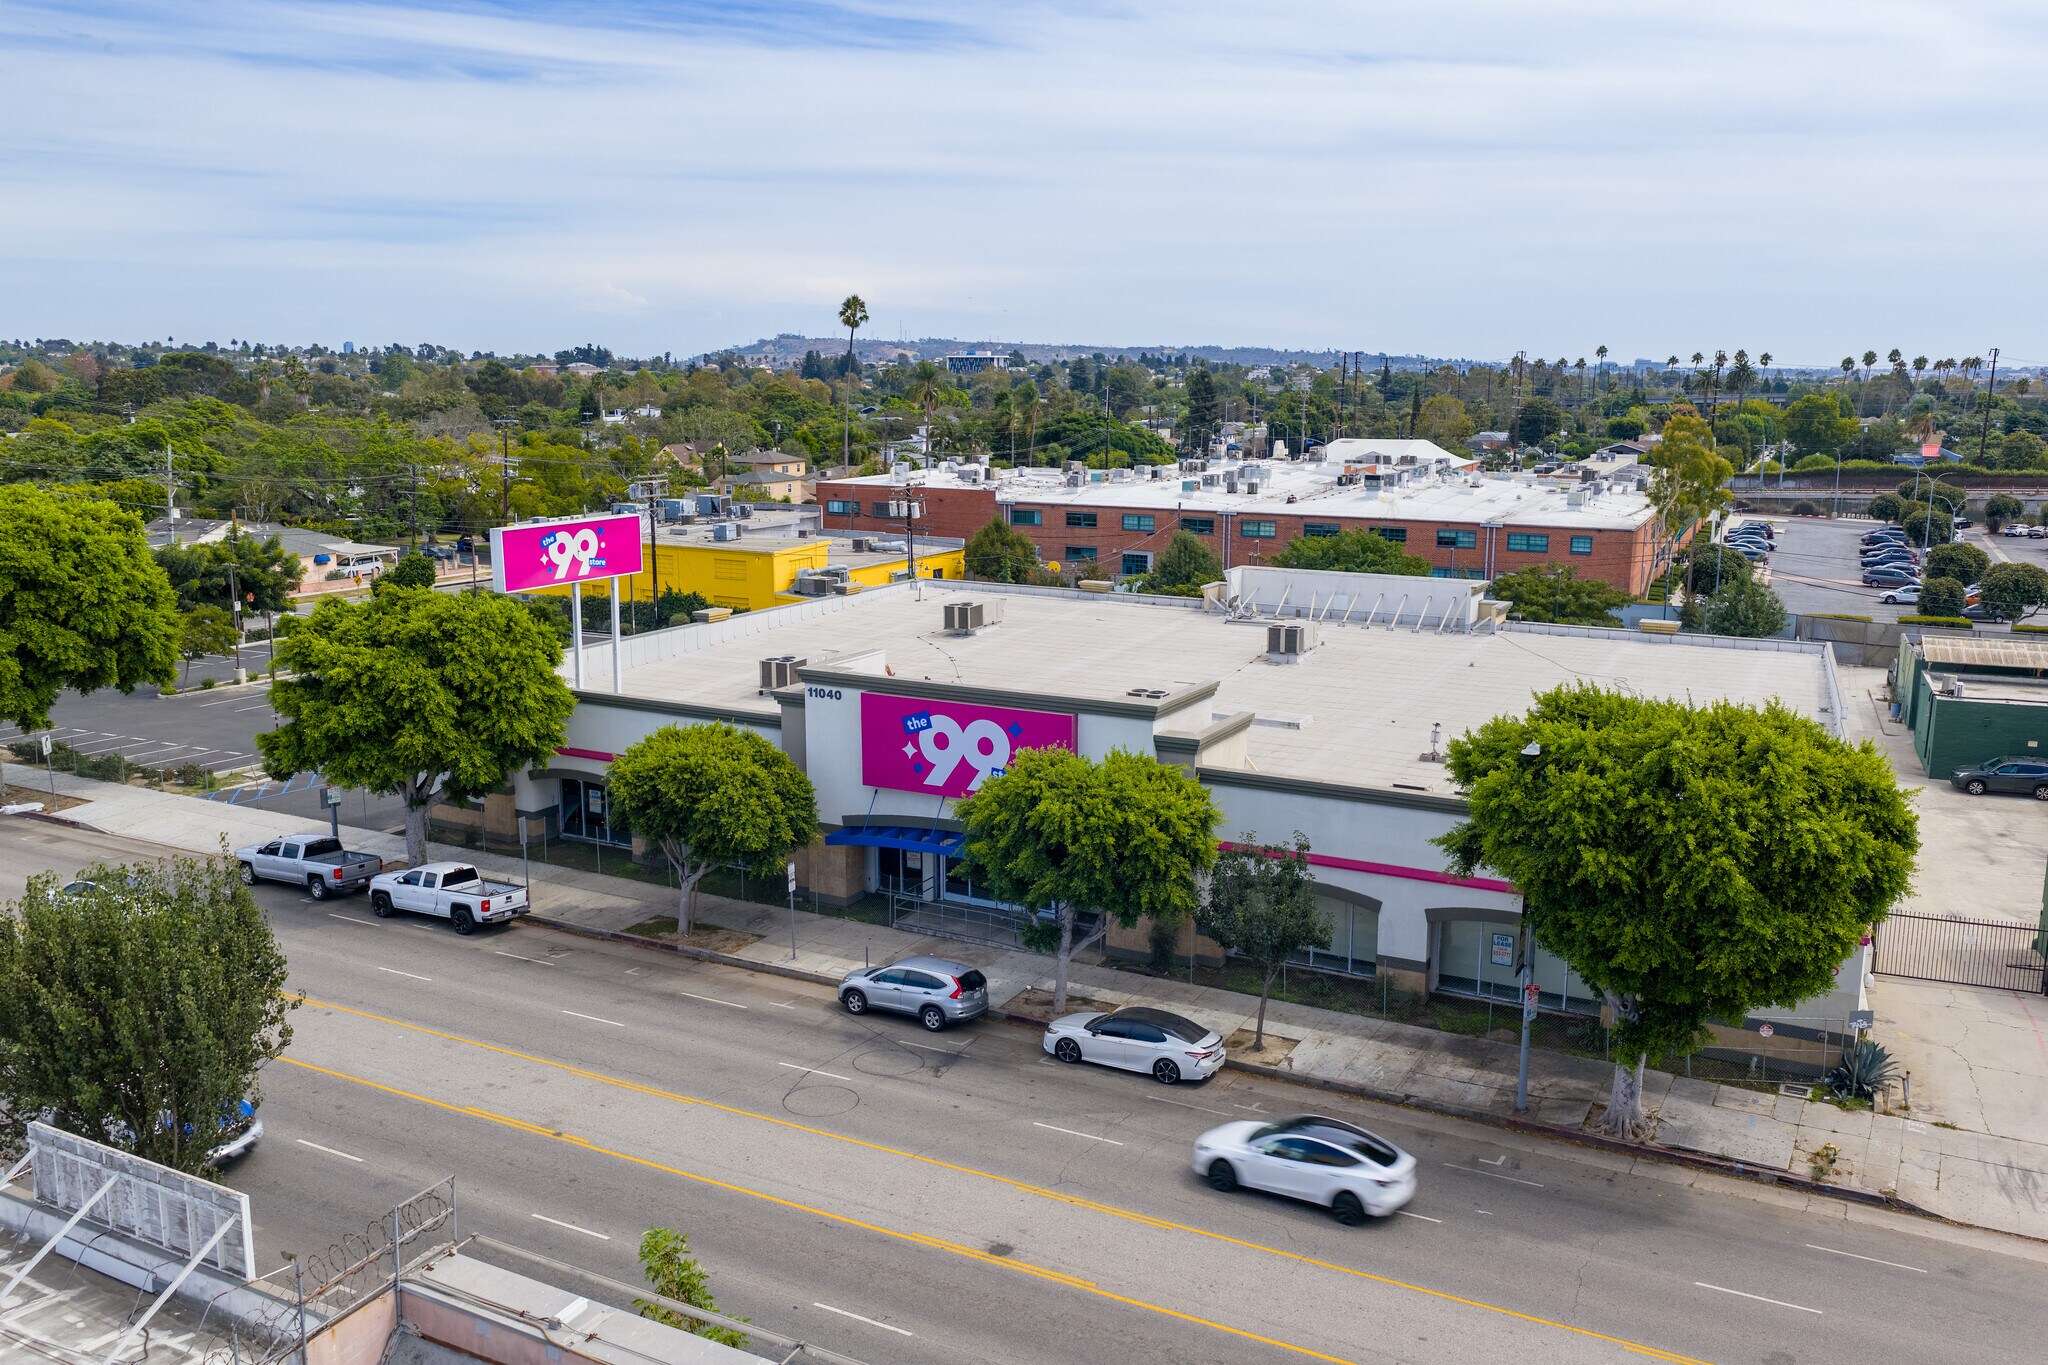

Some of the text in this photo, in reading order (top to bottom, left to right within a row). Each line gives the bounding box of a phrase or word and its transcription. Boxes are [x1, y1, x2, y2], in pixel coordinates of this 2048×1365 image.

[542, 536, 555, 546] the
[548, 528, 598, 579] 99
[808, 687, 842, 700] 11040
[907, 714, 1010, 791] the 99
[1493, 940, 1512, 949] LEASE
